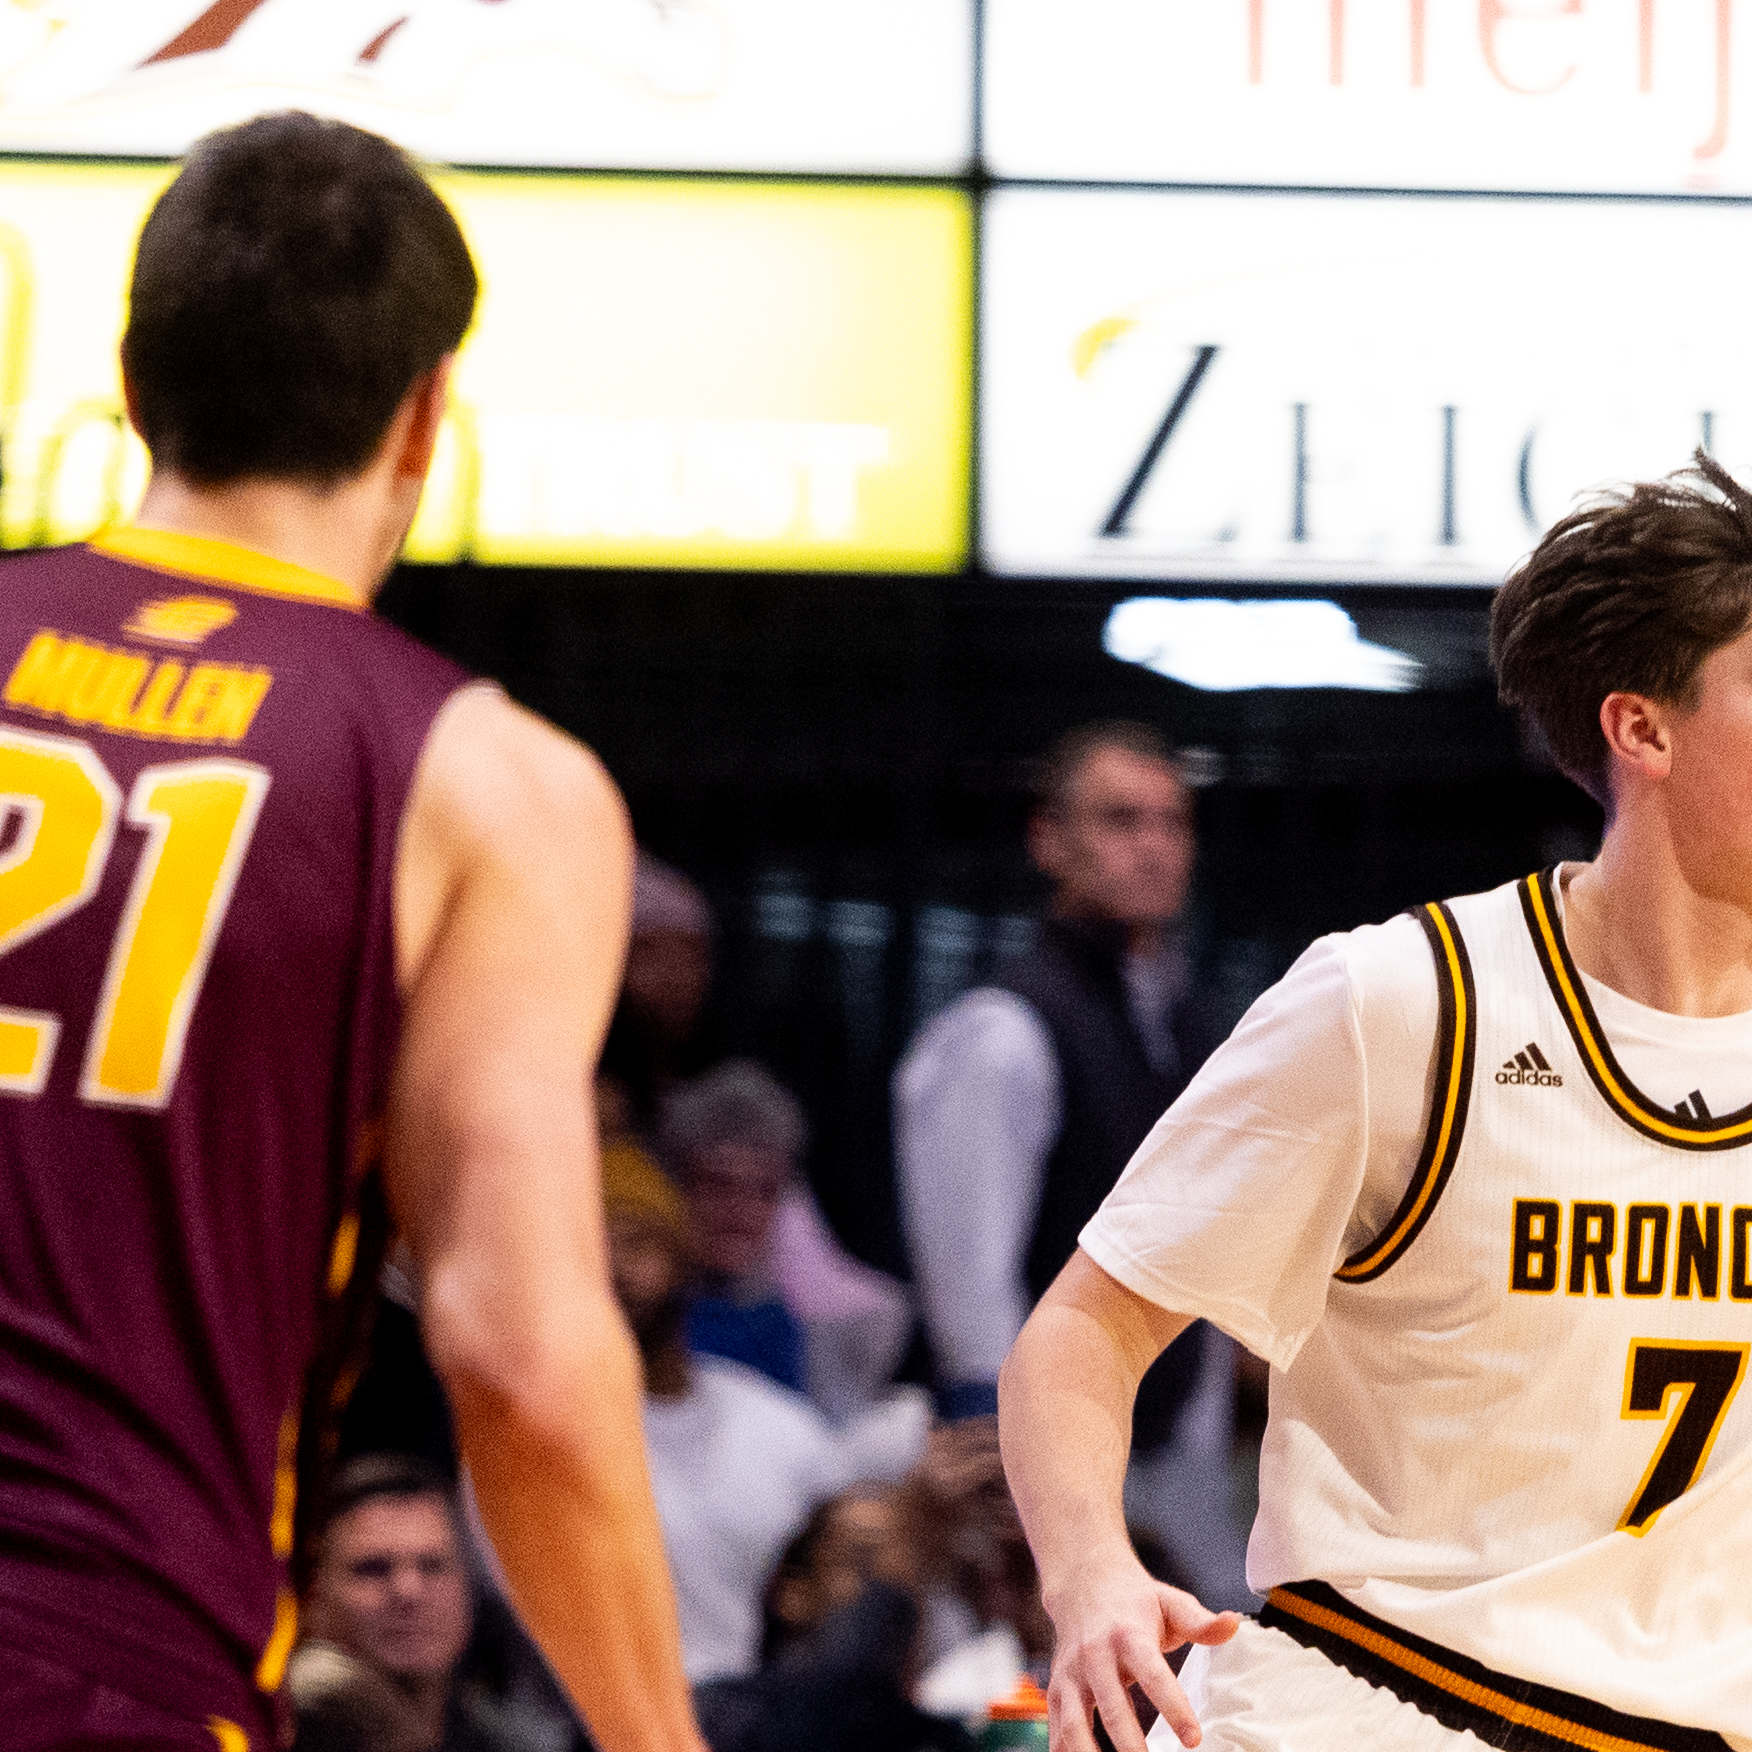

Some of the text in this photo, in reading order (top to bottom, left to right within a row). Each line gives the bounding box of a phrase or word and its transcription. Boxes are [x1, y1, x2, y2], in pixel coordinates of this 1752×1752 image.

[4, 628, 274, 745] MULLEN
[1494, 1067, 1564, 1087] adidas
[1615, 1336, 1752, 1539] 7
